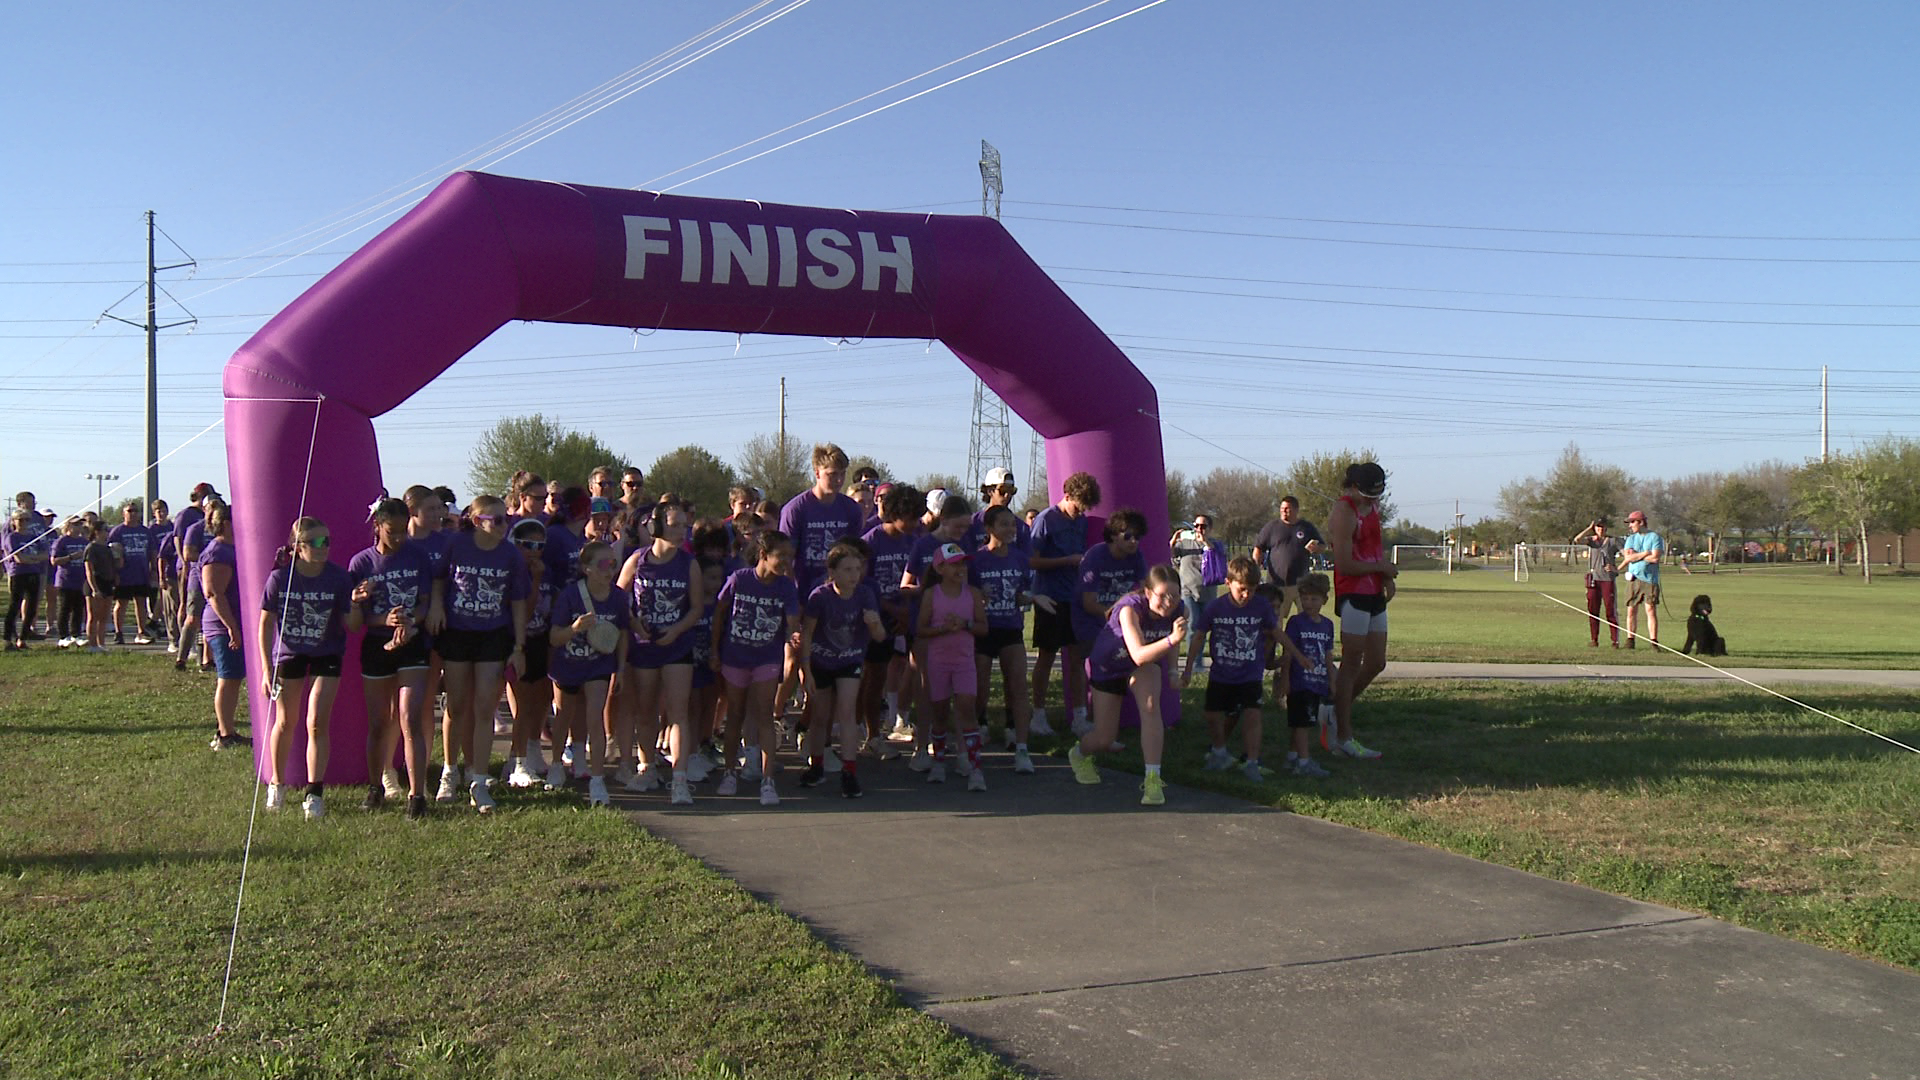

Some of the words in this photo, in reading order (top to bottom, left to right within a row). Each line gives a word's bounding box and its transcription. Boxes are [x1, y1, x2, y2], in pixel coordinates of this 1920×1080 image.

[622, 214, 915, 294] FINISH
[386, 570, 402, 580] 5K
[402, 569, 419, 577] for
[479, 567, 495, 577] 5K
[655, 579, 670, 588] 5K
[671, 579, 687, 588] for
[303, 591, 319, 600] 5K
[320, 592, 335, 600] for
[734, 593, 757, 604] 2026
[773, 598, 785, 608] fr
[1235, 616, 1250, 625] 5K
